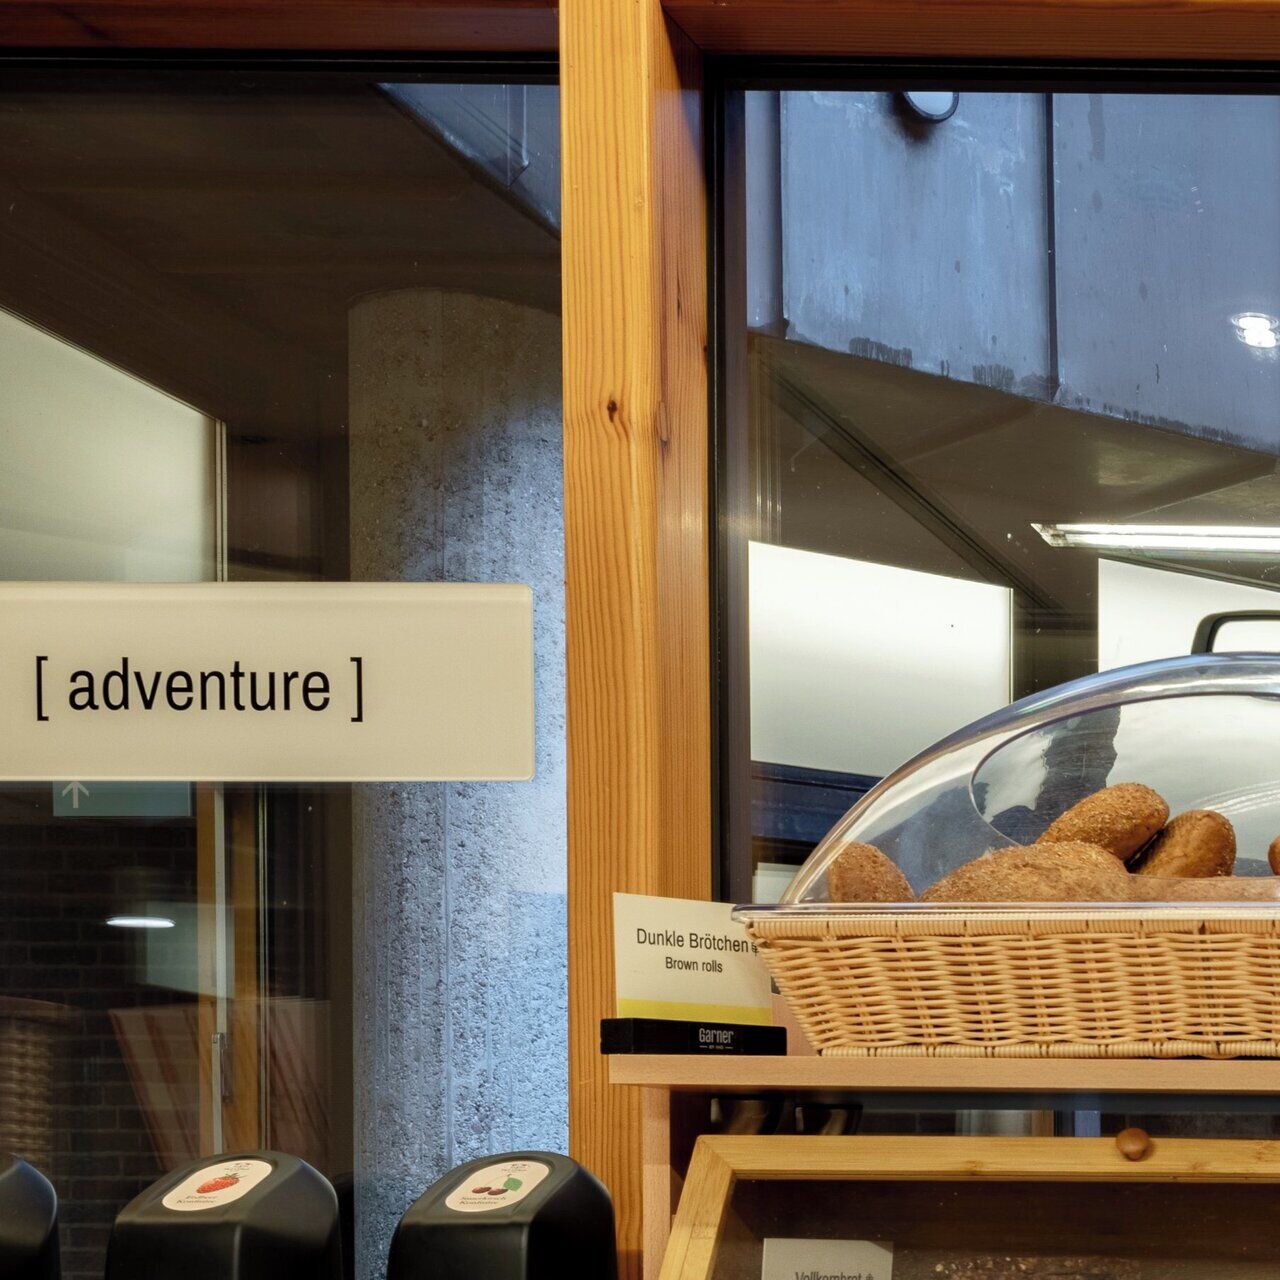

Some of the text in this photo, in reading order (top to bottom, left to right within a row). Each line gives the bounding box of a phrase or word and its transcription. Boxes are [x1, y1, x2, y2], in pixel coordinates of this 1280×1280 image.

[68, 657, 331, 711] adventure
[637, 928, 749, 953] Dunkle Brötchen
[665, 956, 723, 973] Brown rolls
[699, 1027, 735, 1044] Garner
